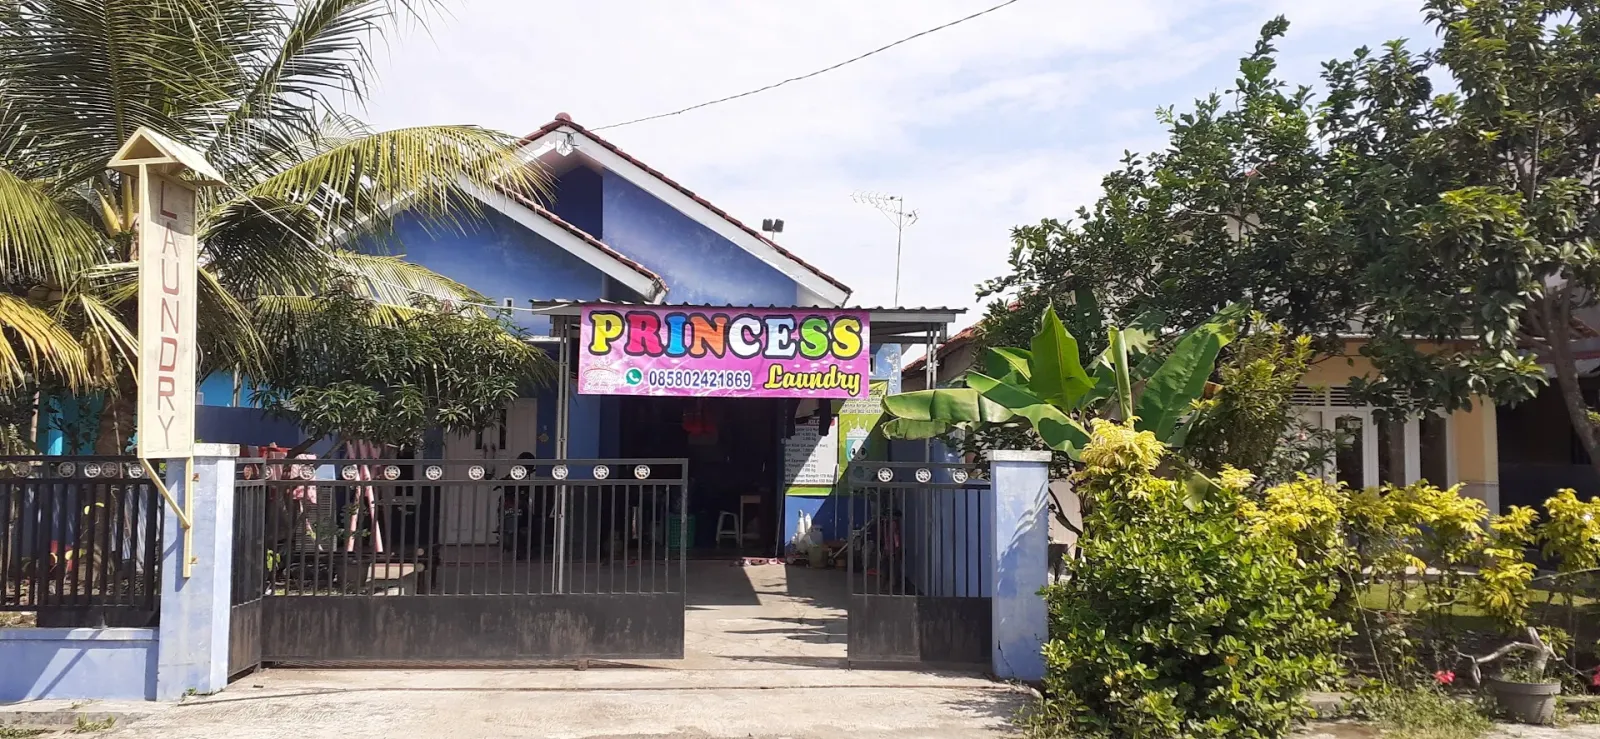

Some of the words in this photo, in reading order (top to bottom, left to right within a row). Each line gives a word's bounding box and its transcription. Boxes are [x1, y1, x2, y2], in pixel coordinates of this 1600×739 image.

[157, 181, 180, 449] LAUNDRY
[590, 311, 863, 359] PRINCESS
[649, 369, 752, 390] 085802421869
[764, 363, 861, 396] Laundry
